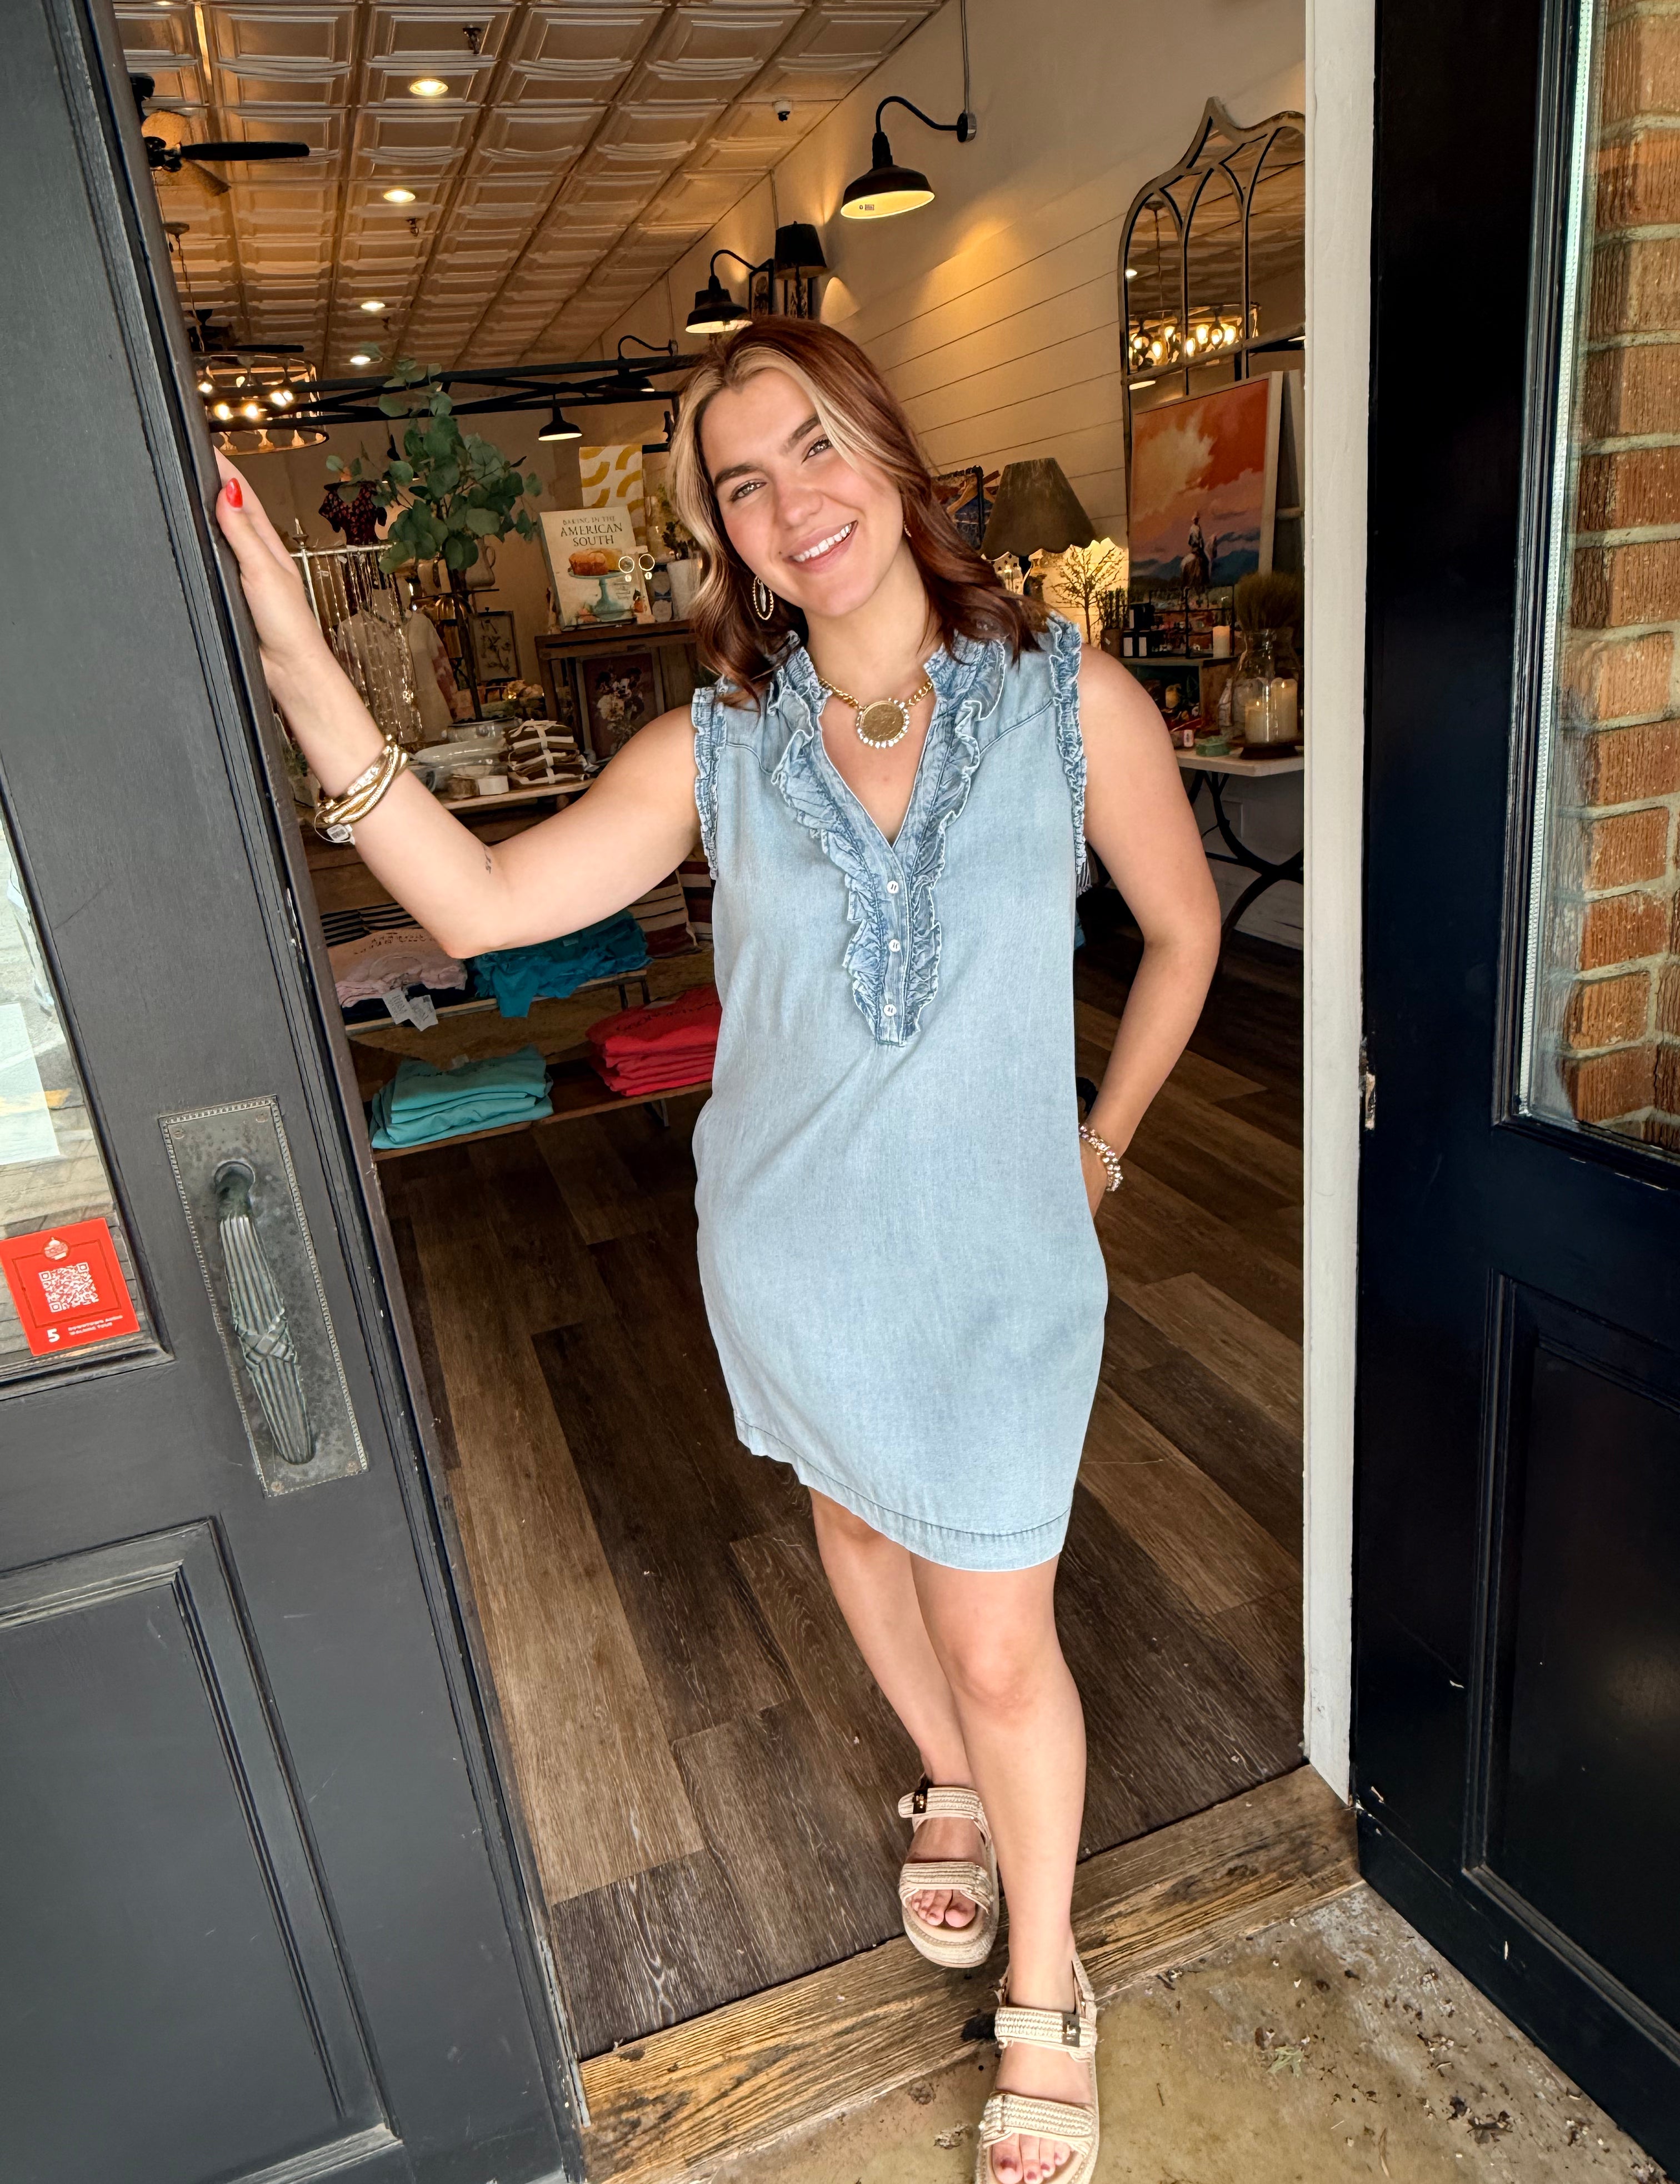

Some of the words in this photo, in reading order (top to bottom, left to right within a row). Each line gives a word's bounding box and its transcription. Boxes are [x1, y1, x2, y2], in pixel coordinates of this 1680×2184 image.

[561, 522, 623, 537] AMERICAN
[573, 535, 614, 547] SOUTH
[47, 1328, 60, 1342] 5
